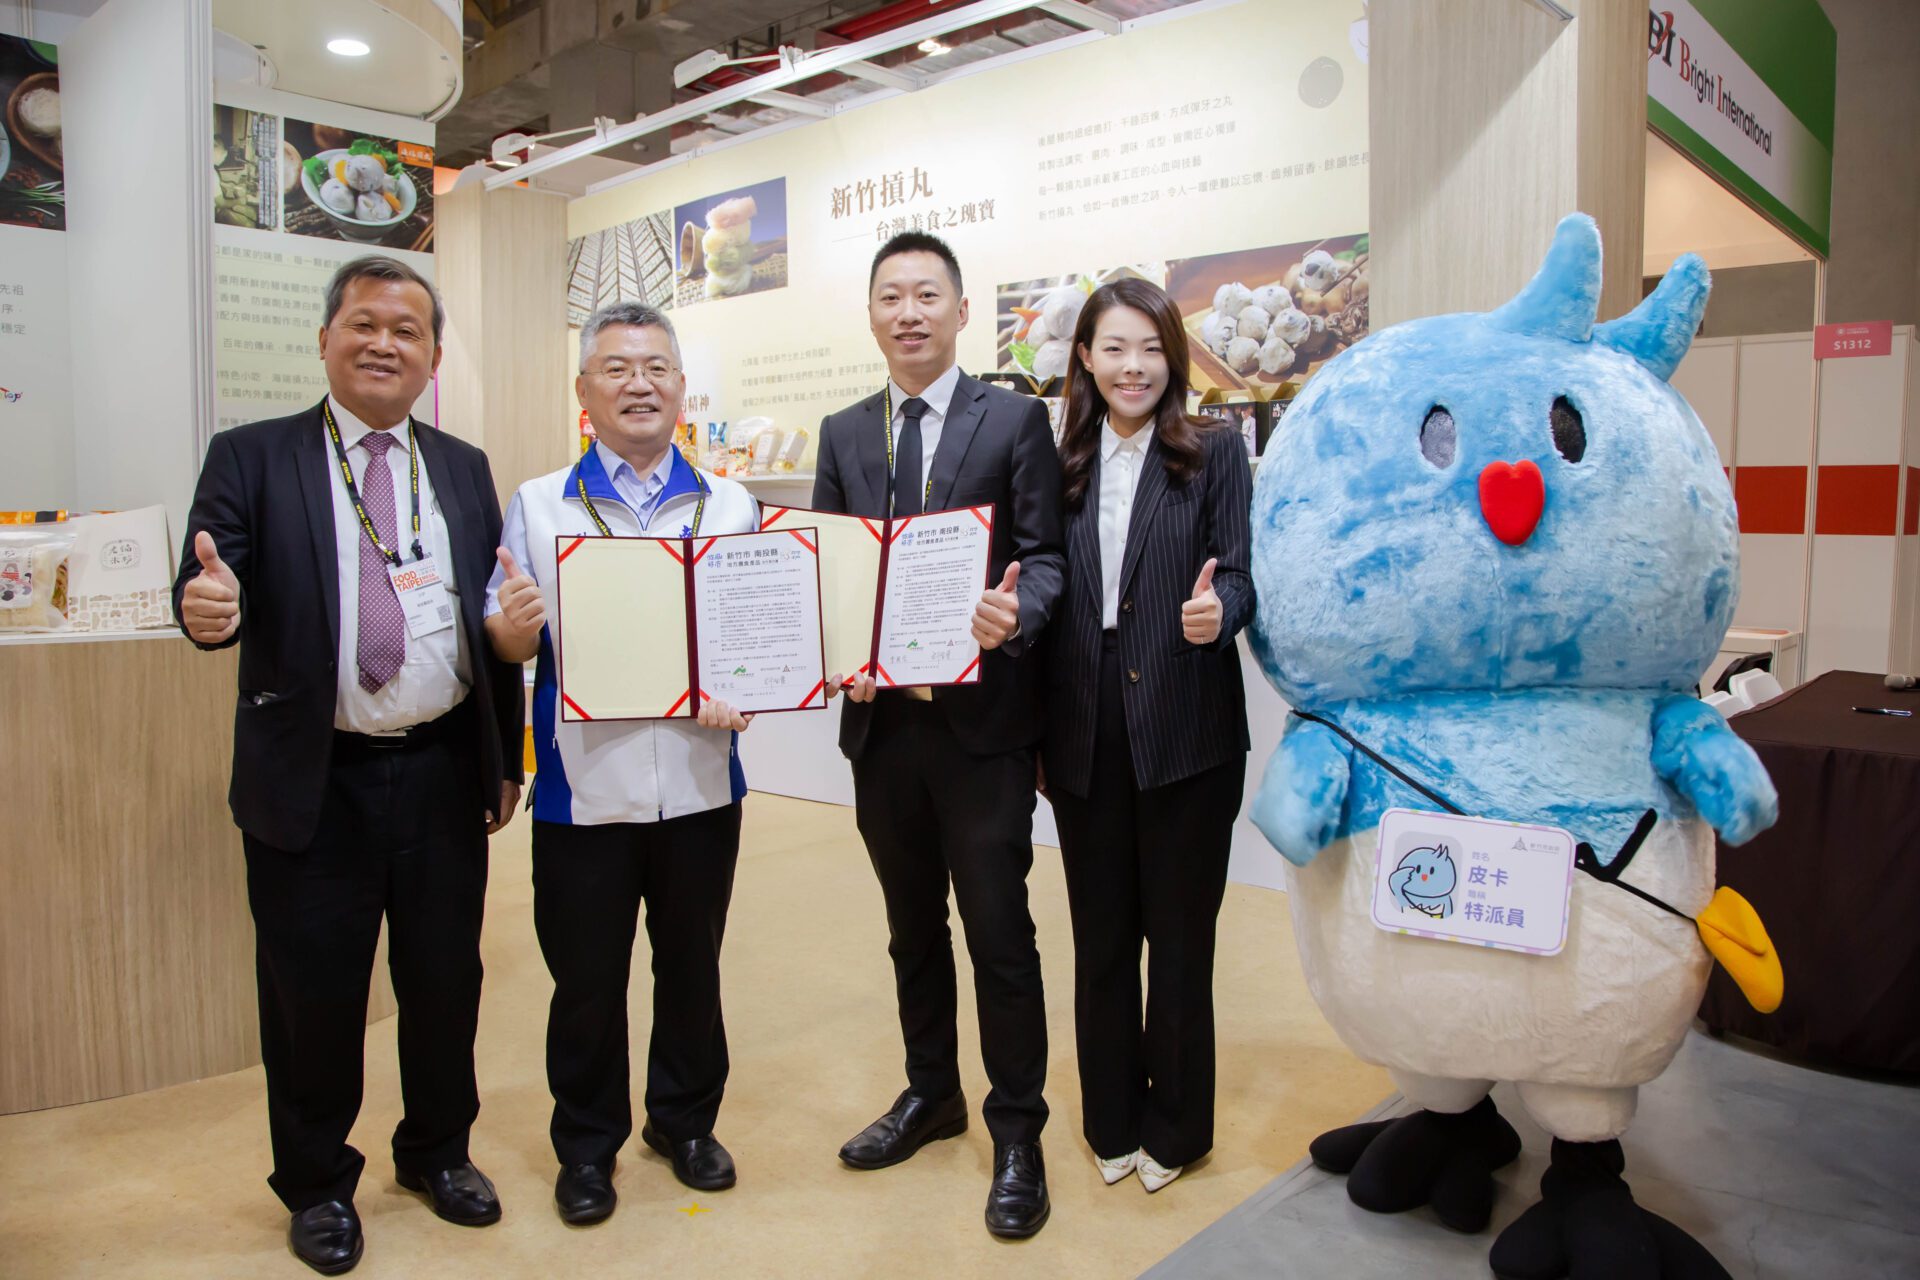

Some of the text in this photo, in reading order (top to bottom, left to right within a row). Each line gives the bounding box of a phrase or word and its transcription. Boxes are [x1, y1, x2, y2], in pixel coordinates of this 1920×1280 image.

[1679, 37, 1714, 104] Bright
[1716, 74, 1772, 157] International
[831, 167, 934, 220] 新竹摃丸
[1833, 339, 1872, 351] S1312
[917, 530, 937, 538] 新竹市
[727, 548, 778, 560] 新竹市 南投縣
[393, 570, 417, 584] FOOD
[395, 577, 424, 592] TAIPEI
[1471, 851, 1490, 862] 姓名
[1467, 865, 1509, 888] 皮卡
[1464, 901, 1525, 929] 特派員
